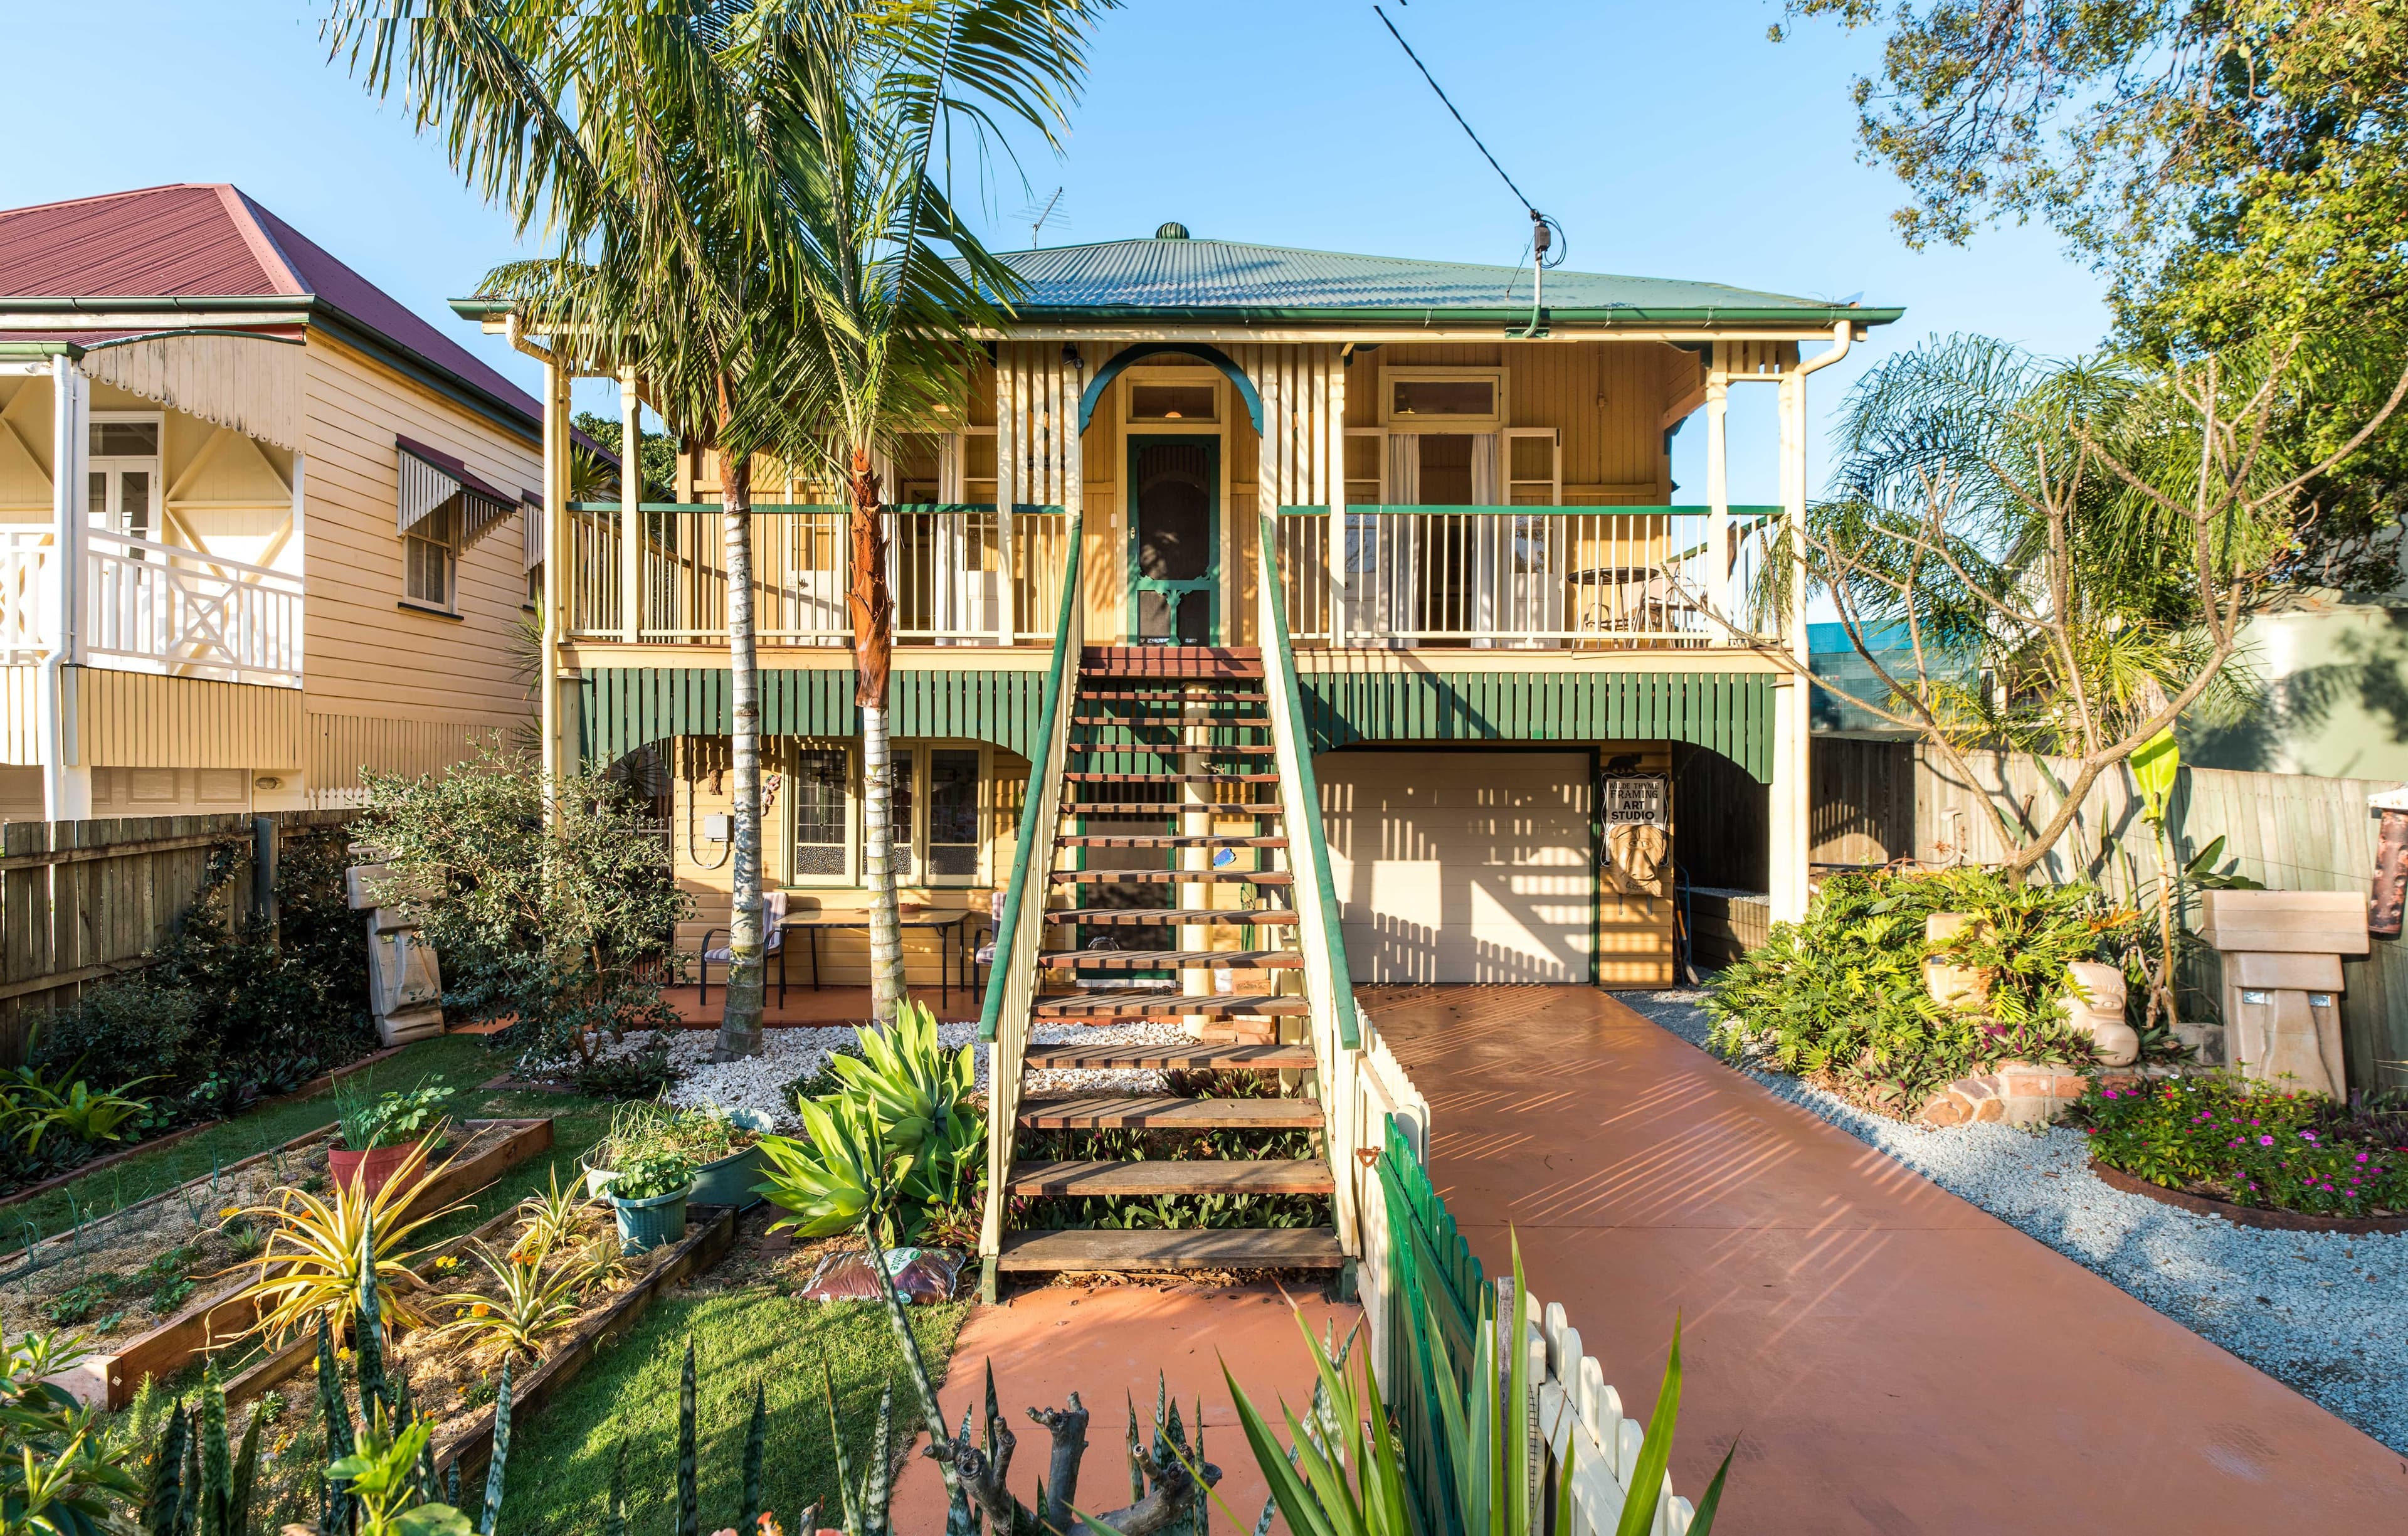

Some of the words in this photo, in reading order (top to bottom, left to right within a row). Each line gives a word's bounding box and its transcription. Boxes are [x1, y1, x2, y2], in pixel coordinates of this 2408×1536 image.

[1634, 781, 1659, 790] THYME
[1610, 790, 1658, 798] FRAMING
[1623, 801, 1645, 810] ART
[1612, 811, 1655, 820] STUDIO
